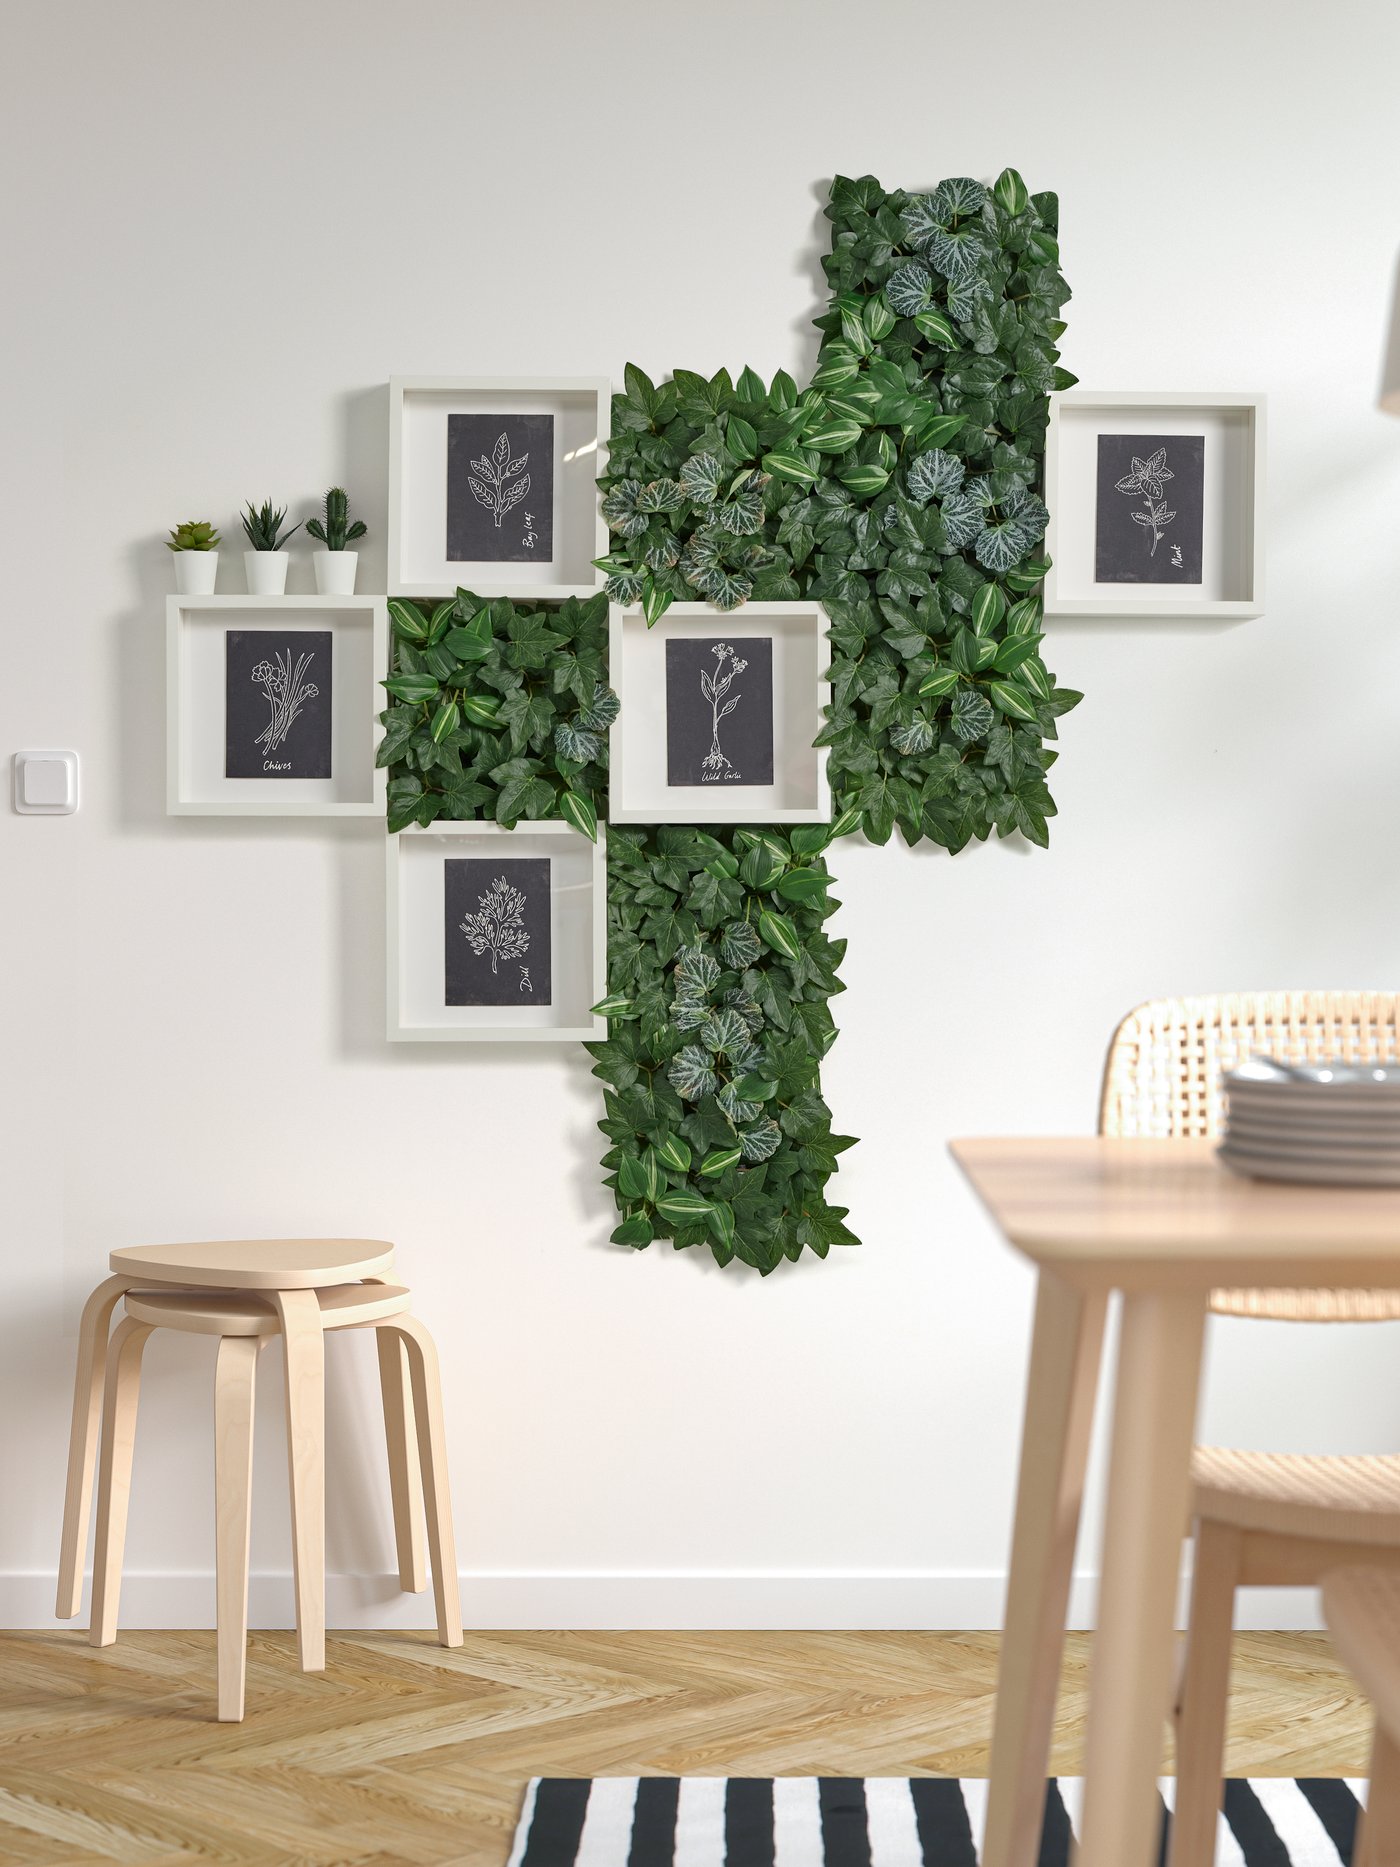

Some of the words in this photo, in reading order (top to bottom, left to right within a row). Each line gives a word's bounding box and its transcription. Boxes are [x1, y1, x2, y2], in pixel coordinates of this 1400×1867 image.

[522, 531, 539, 549] Bay
[1170, 543, 1184, 569] Mint
[263, 760, 292, 771] Chives
[701, 771, 721, 782] Wild
[723, 770, 742, 780] Garlic
[519, 965, 533, 992] Dill
